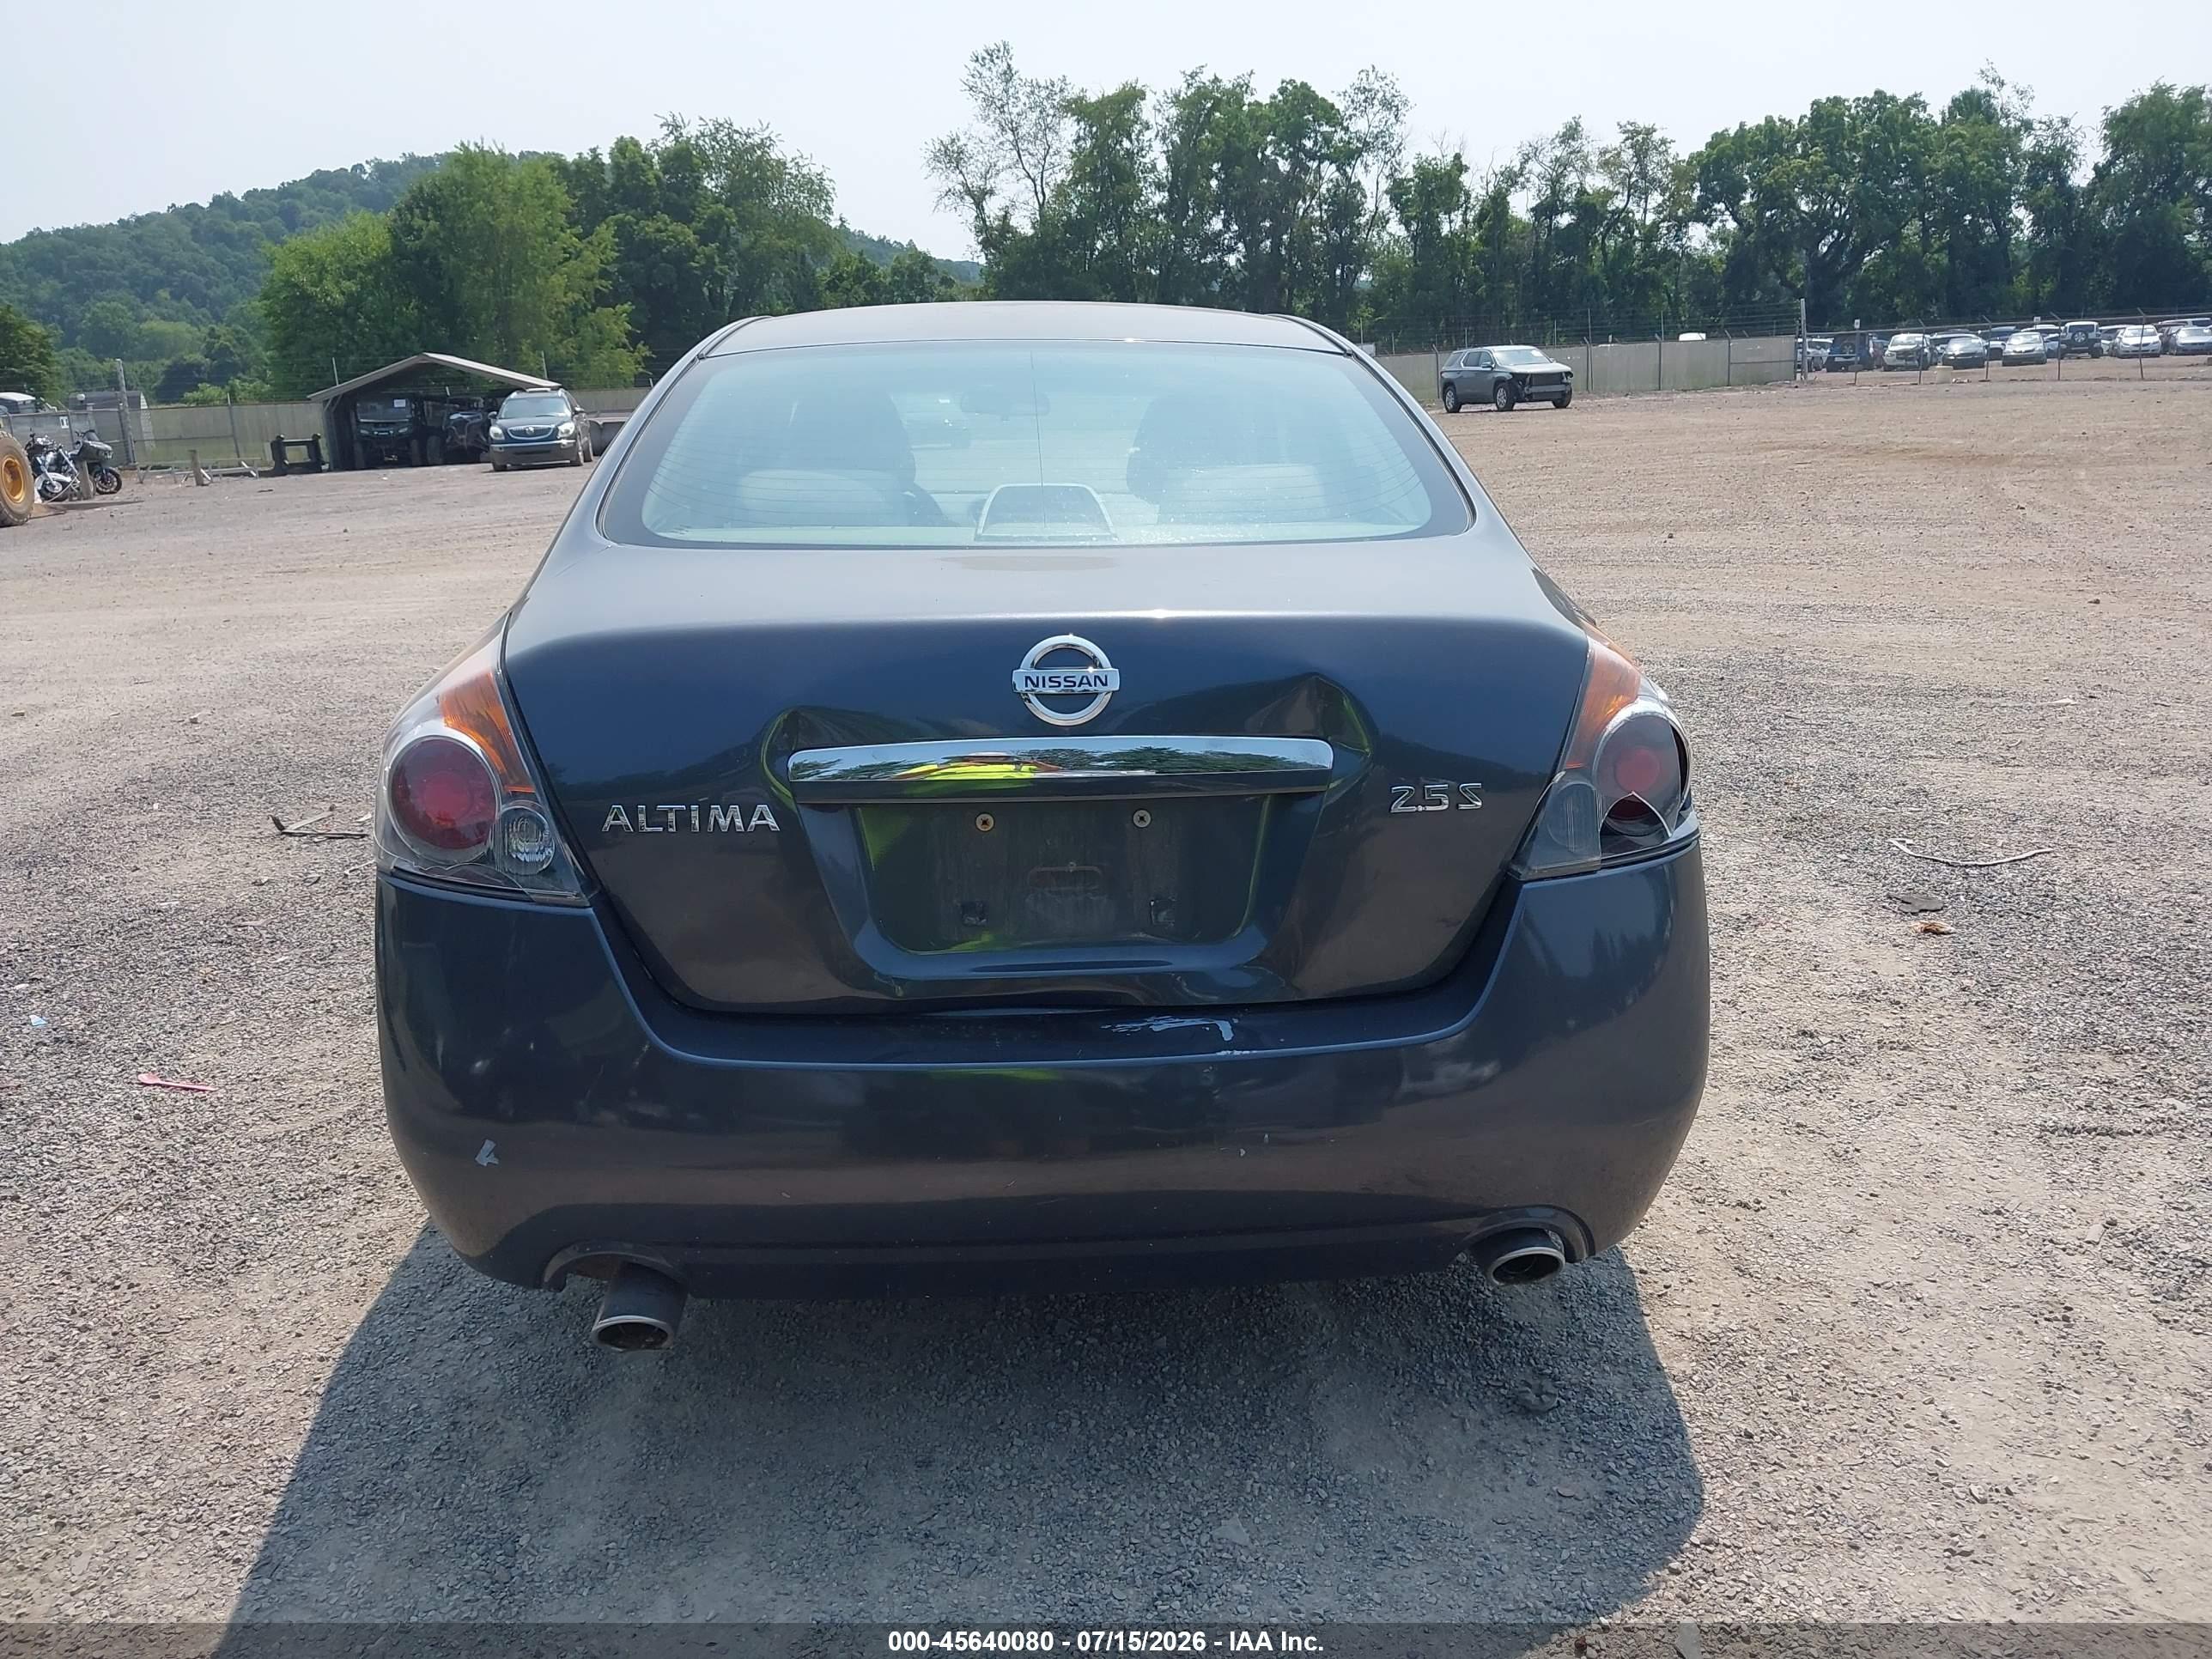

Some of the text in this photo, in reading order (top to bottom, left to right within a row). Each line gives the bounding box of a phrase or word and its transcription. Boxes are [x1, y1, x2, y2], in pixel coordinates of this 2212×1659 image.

[1024, 675, 1109, 689] NISSAN
[1390, 782, 1483, 813] 2.5 S
[601, 805, 781, 832] ALTIMA
